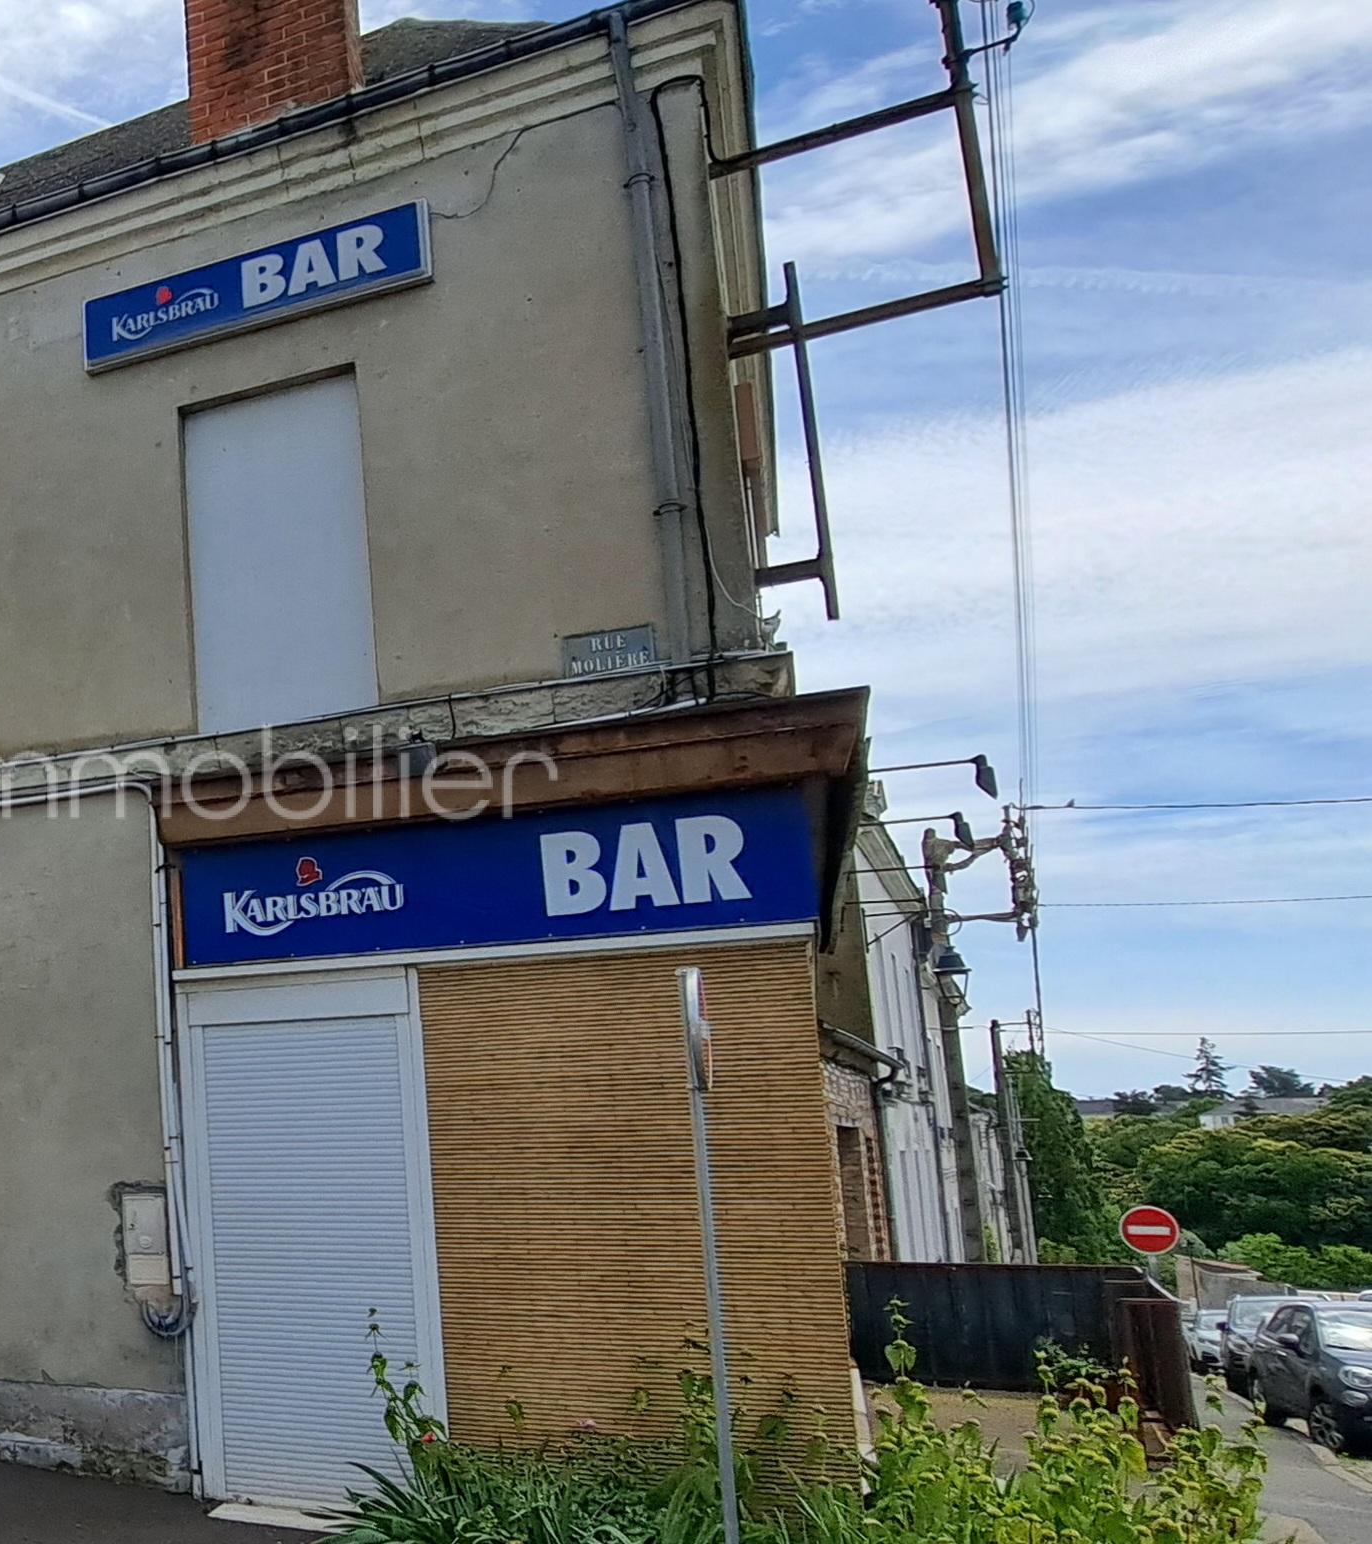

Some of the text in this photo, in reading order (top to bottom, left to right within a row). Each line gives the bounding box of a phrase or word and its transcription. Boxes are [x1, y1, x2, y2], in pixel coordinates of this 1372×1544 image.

[241, 224, 387, 308] BAR
[590, 634, 627, 652] RUE
[223, 815, 752, 936] KARLSBRÄU BAR
